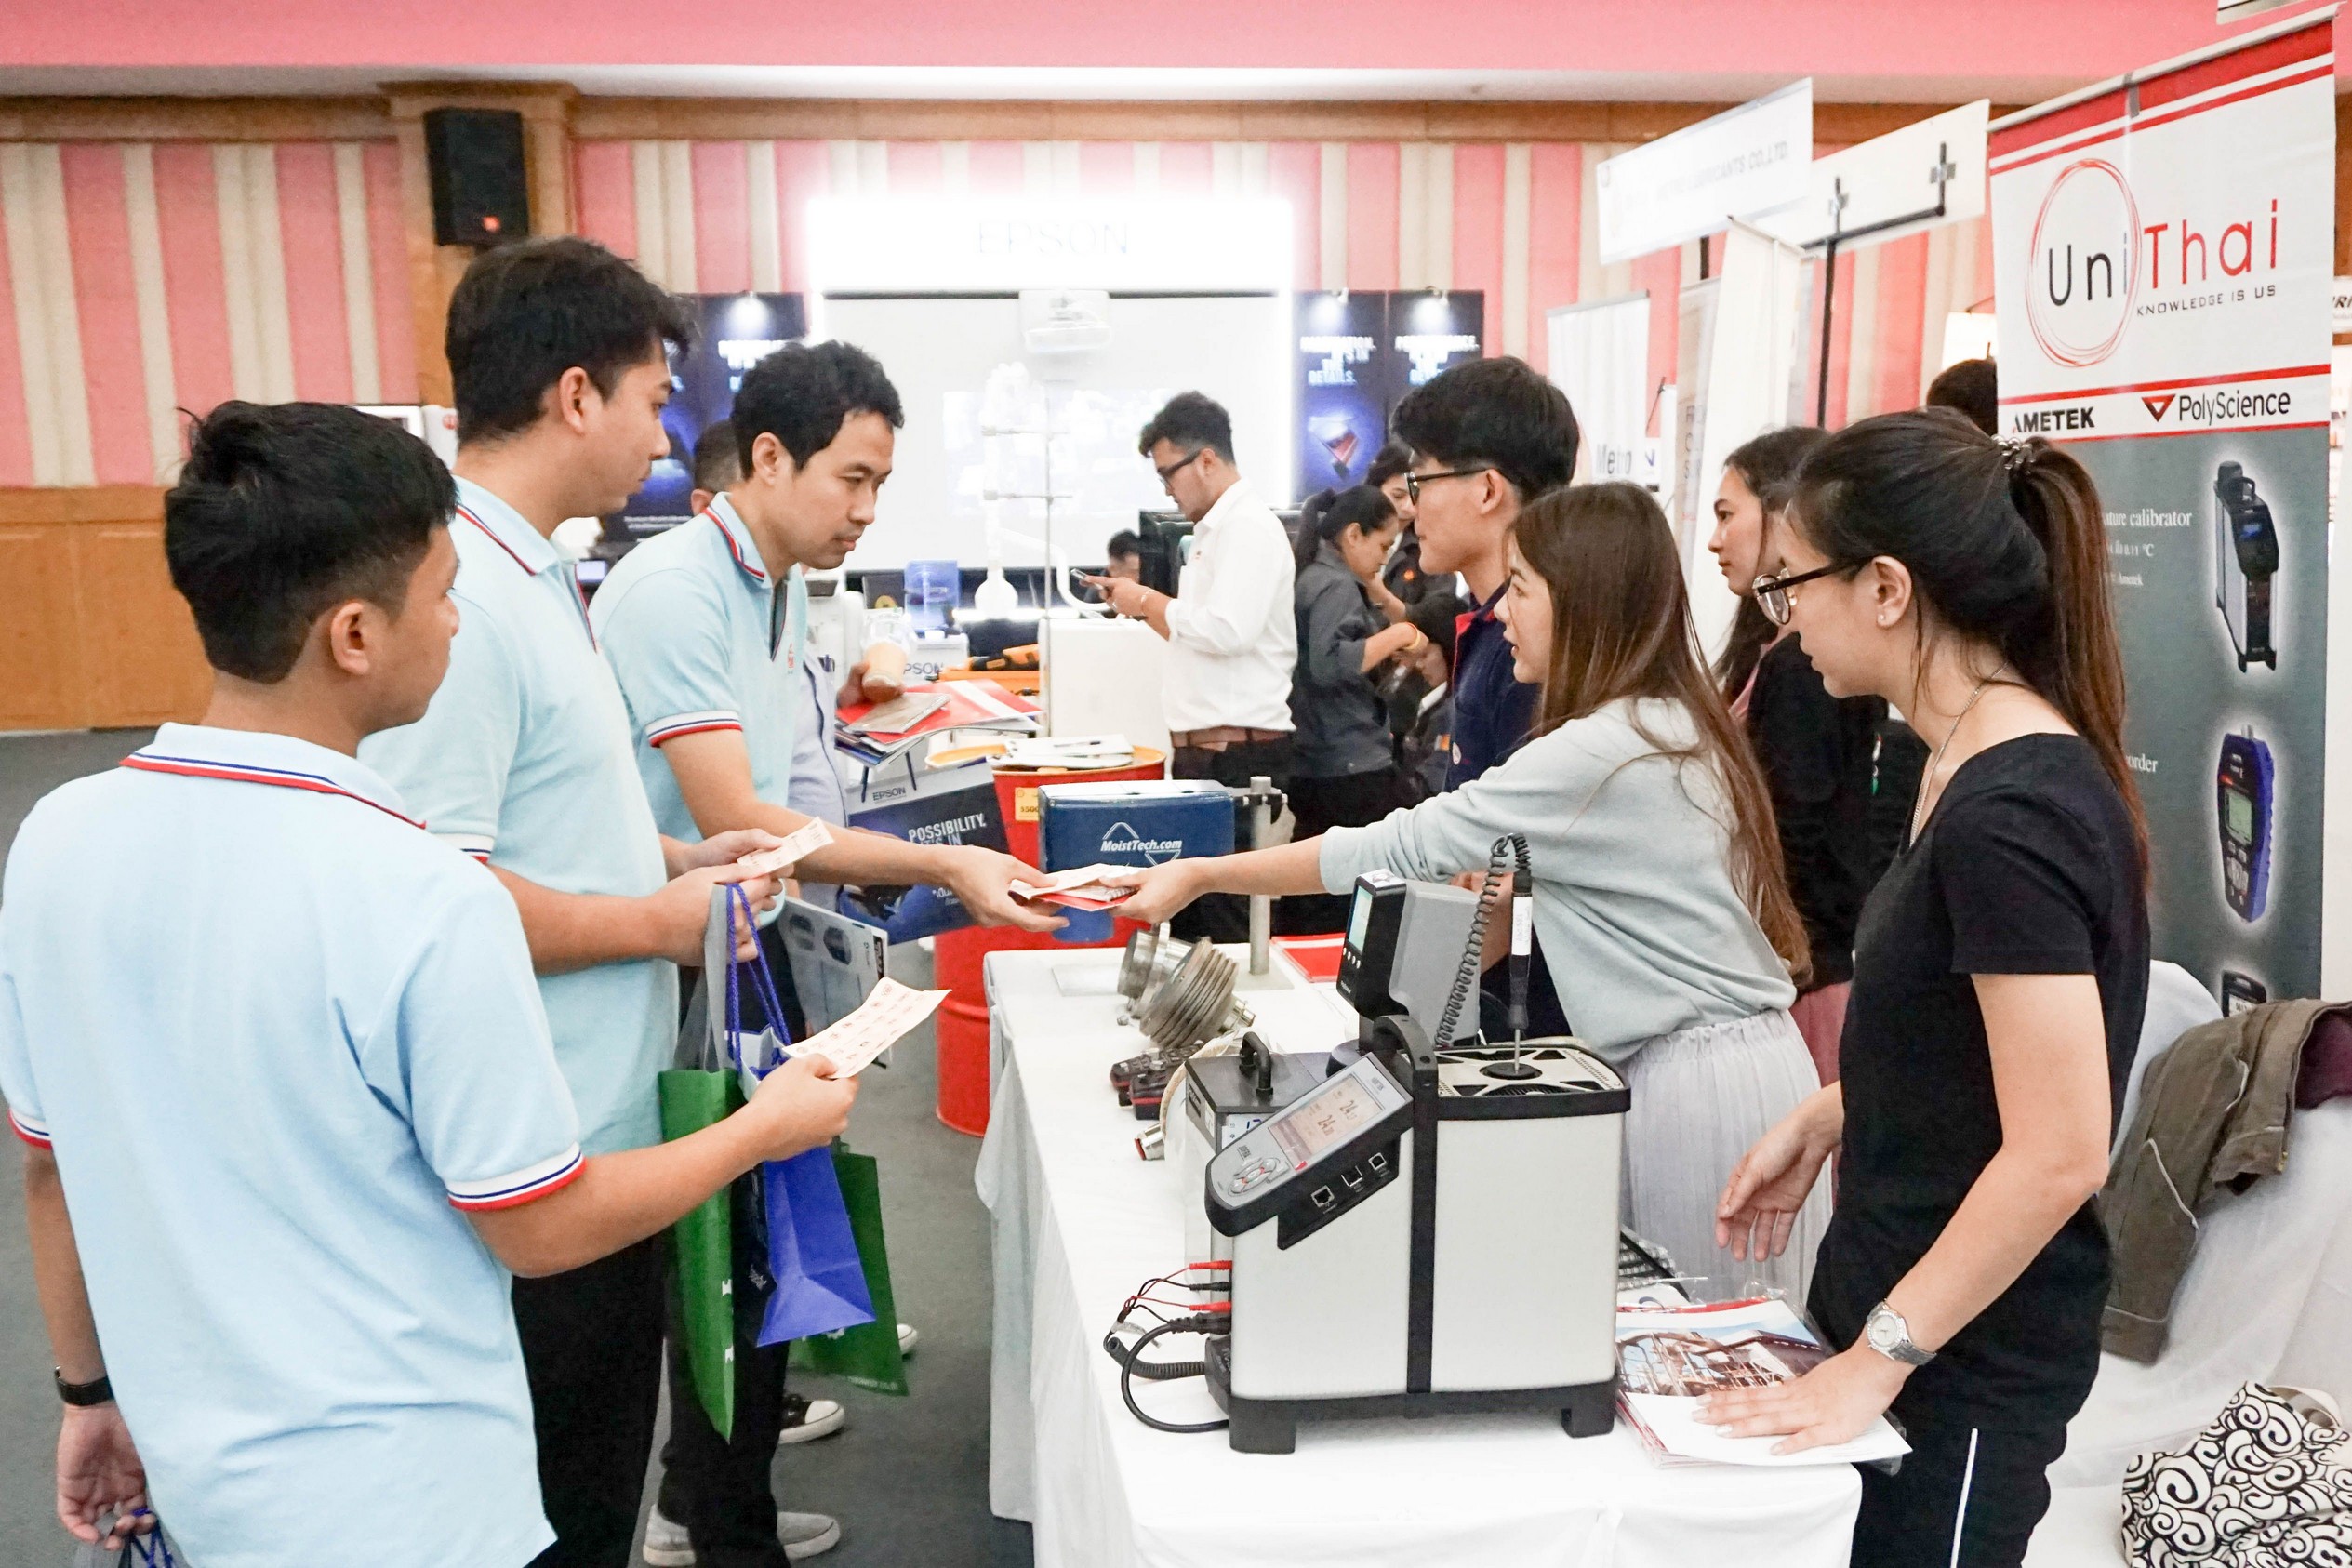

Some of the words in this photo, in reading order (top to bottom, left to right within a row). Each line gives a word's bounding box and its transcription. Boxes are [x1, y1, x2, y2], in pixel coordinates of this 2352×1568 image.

[977, 219, 1129, 257] EPSON
[2136, 293, 2224, 317] KNOWLEDGE
[2231, 289, 2246, 303] IS
[2254, 285, 2277, 299] US
[2012, 406, 2095, 433] AMETEK
[2178, 389, 2291, 426] PolyScience
[2129, 508, 2193, 527] calibrator
[903, 662, 944, 676] PSON
[2126, 752, 2159, 773] order
[872, 787, 906, 801] EPSON
[908, 812, 987, 844] POSSIBILITY.
[1100, 839, 1183, 853] MoistTech.com
